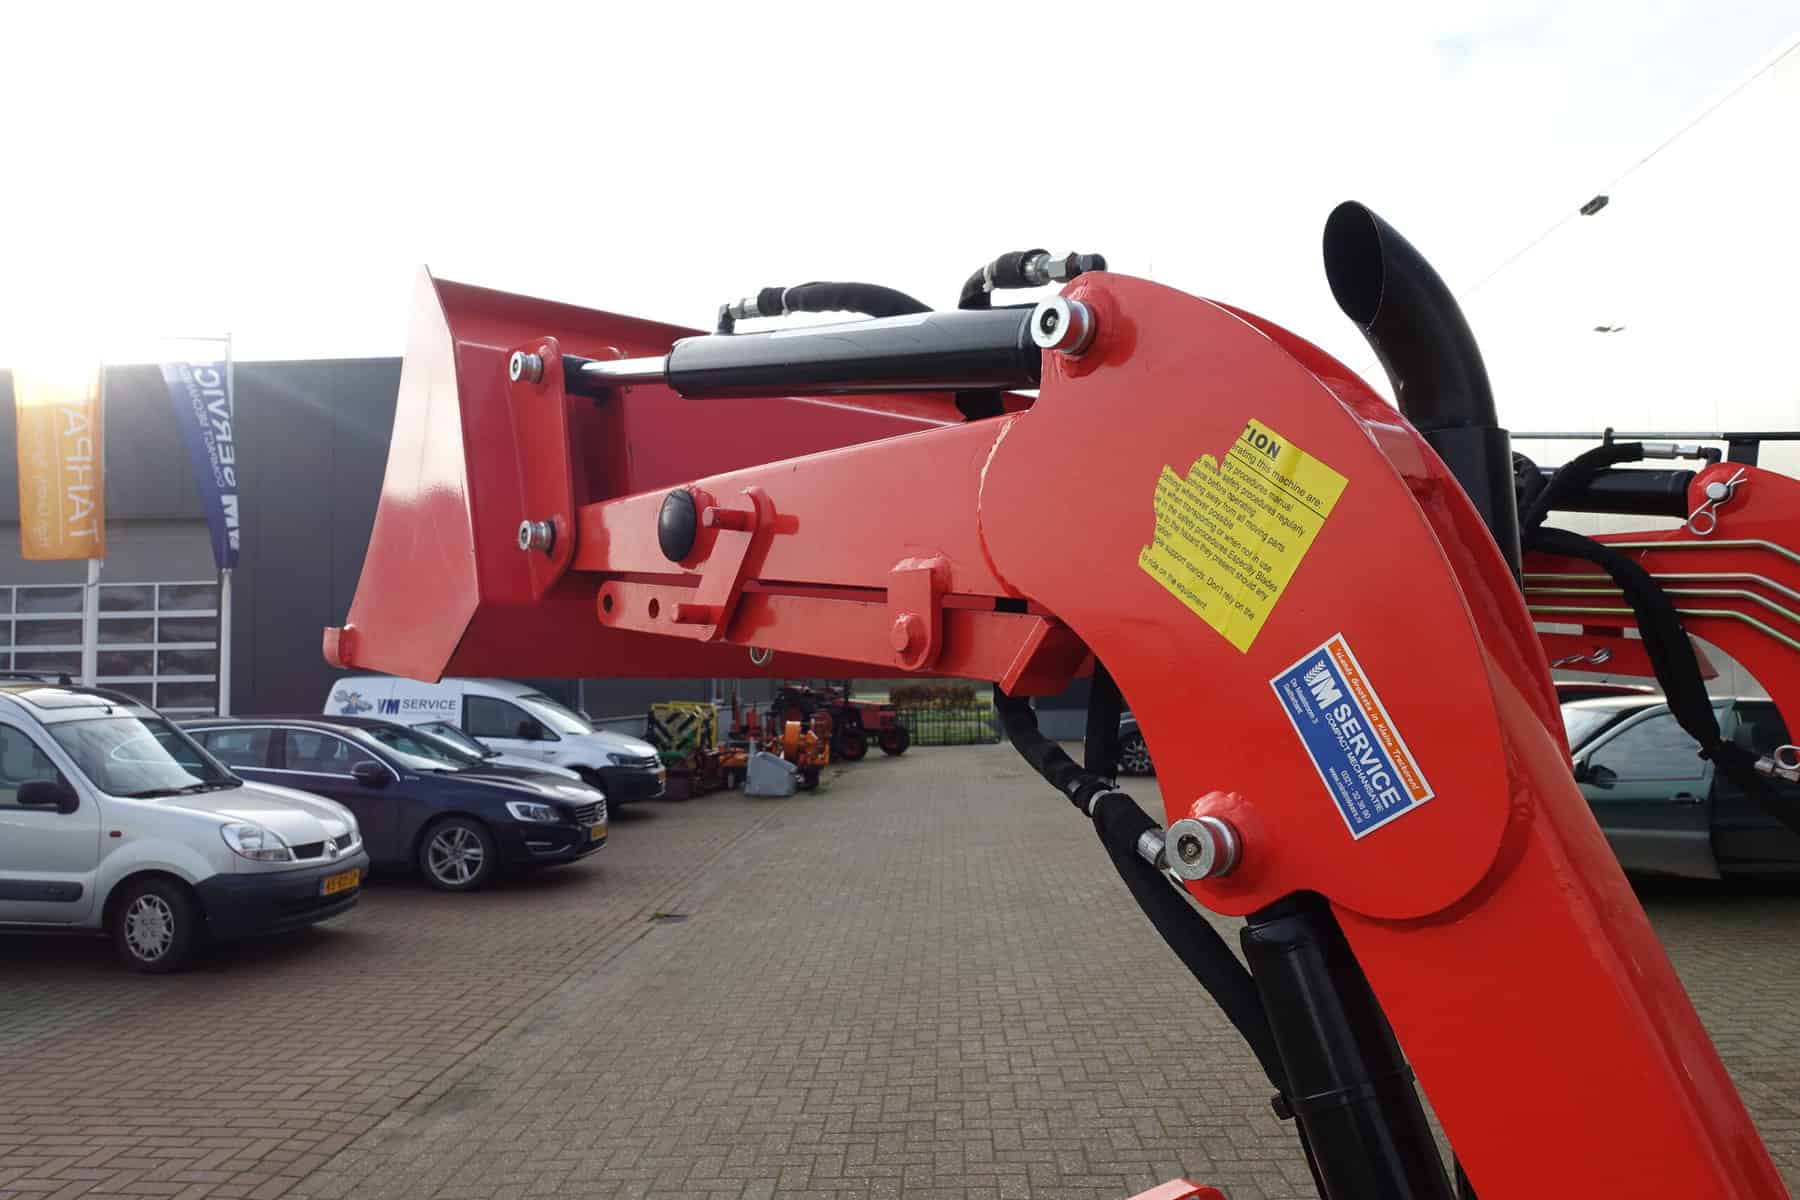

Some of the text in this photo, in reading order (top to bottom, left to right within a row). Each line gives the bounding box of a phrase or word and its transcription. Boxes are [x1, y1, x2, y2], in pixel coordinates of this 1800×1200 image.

[1232, 466, 1269, 496] procedures
[1256, 458, 1273, 473] this
[1271, 469, 1306, 497] machine
[1220, 502, 1236, 516] from
[1243, 519, 1269, 541] moving
[1238, 485, 1277, 516] procedures
[1273, 510, 1305, 538] regularly
[1254, 570, 1279, 592] Blades
[377, 699, 401, 715] VM
[402, 699, 456, 710] SERVICE
[1323, 711, 1384, 813] COMPACT MECHANISATIE
[1331, 700, 1401, 808] SERVICE
